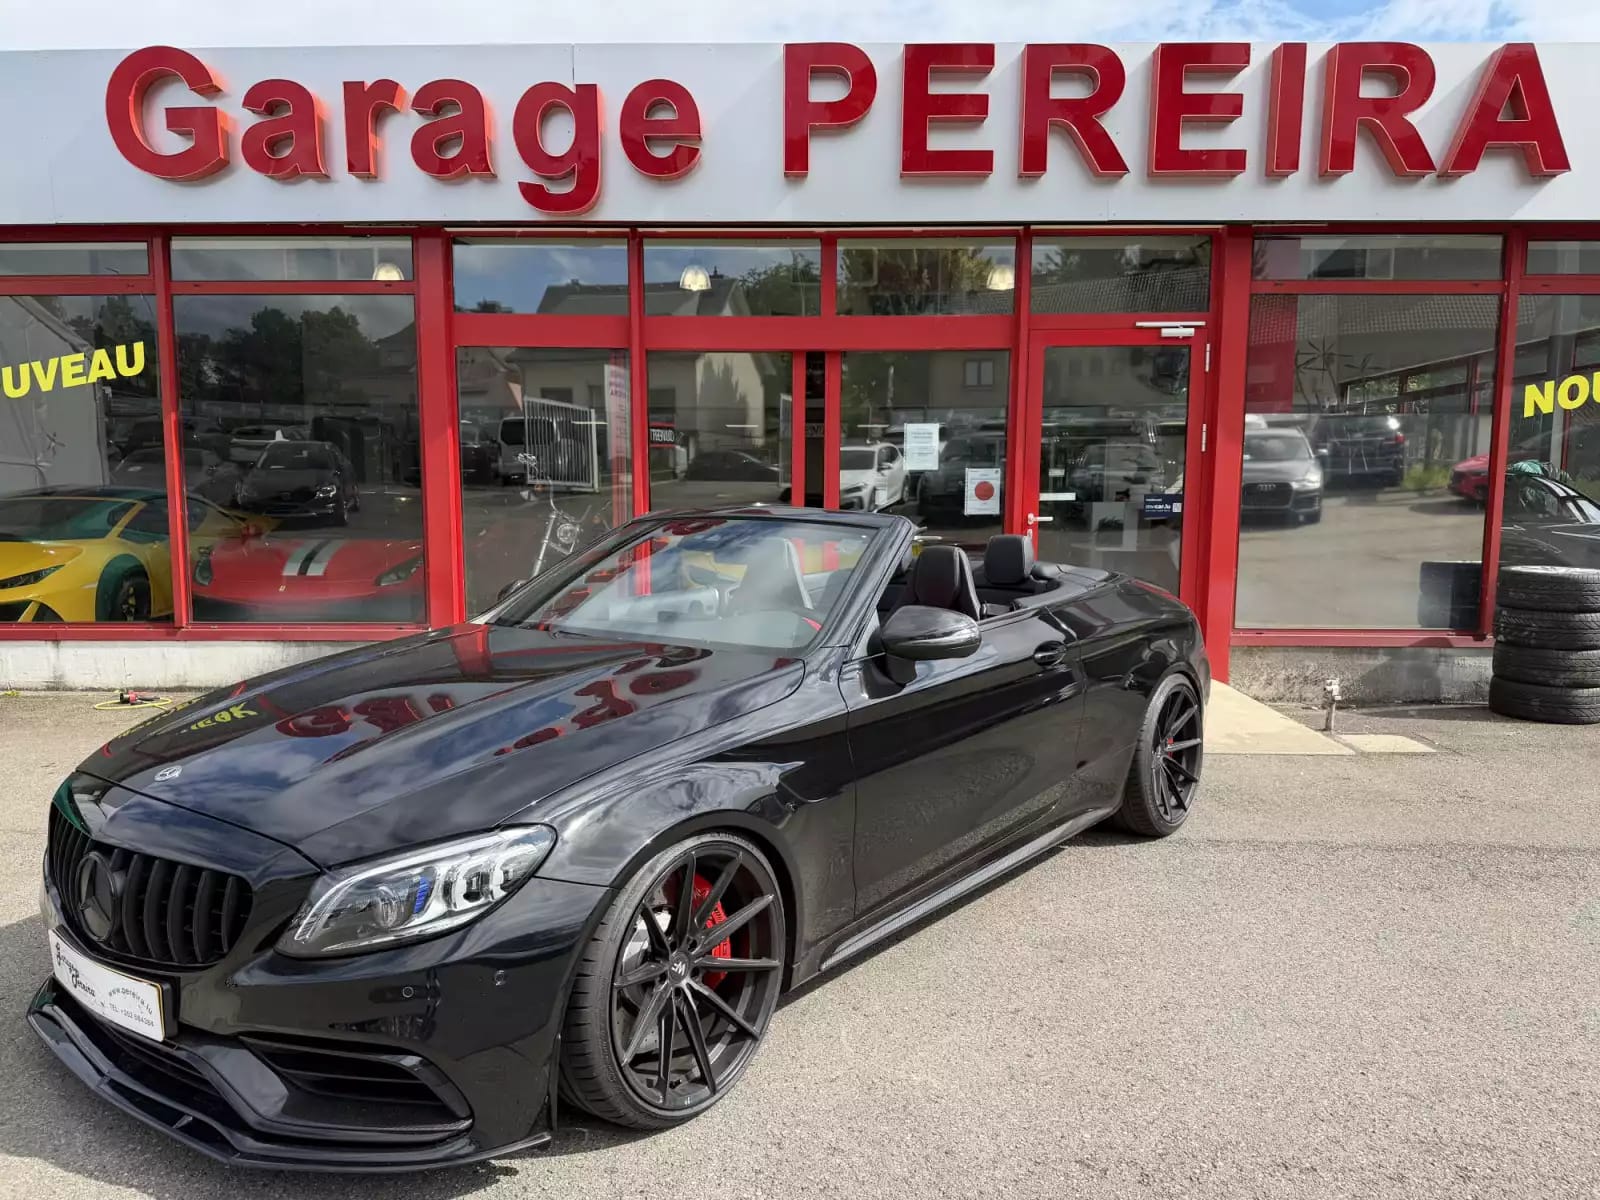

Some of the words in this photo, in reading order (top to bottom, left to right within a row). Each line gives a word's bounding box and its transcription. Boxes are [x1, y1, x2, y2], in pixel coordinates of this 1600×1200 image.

[105, 45, 703, 216] Garage
[783, 42, 1572, 178] PEREIRA
[1, 341, 145, 399] UVEAU
